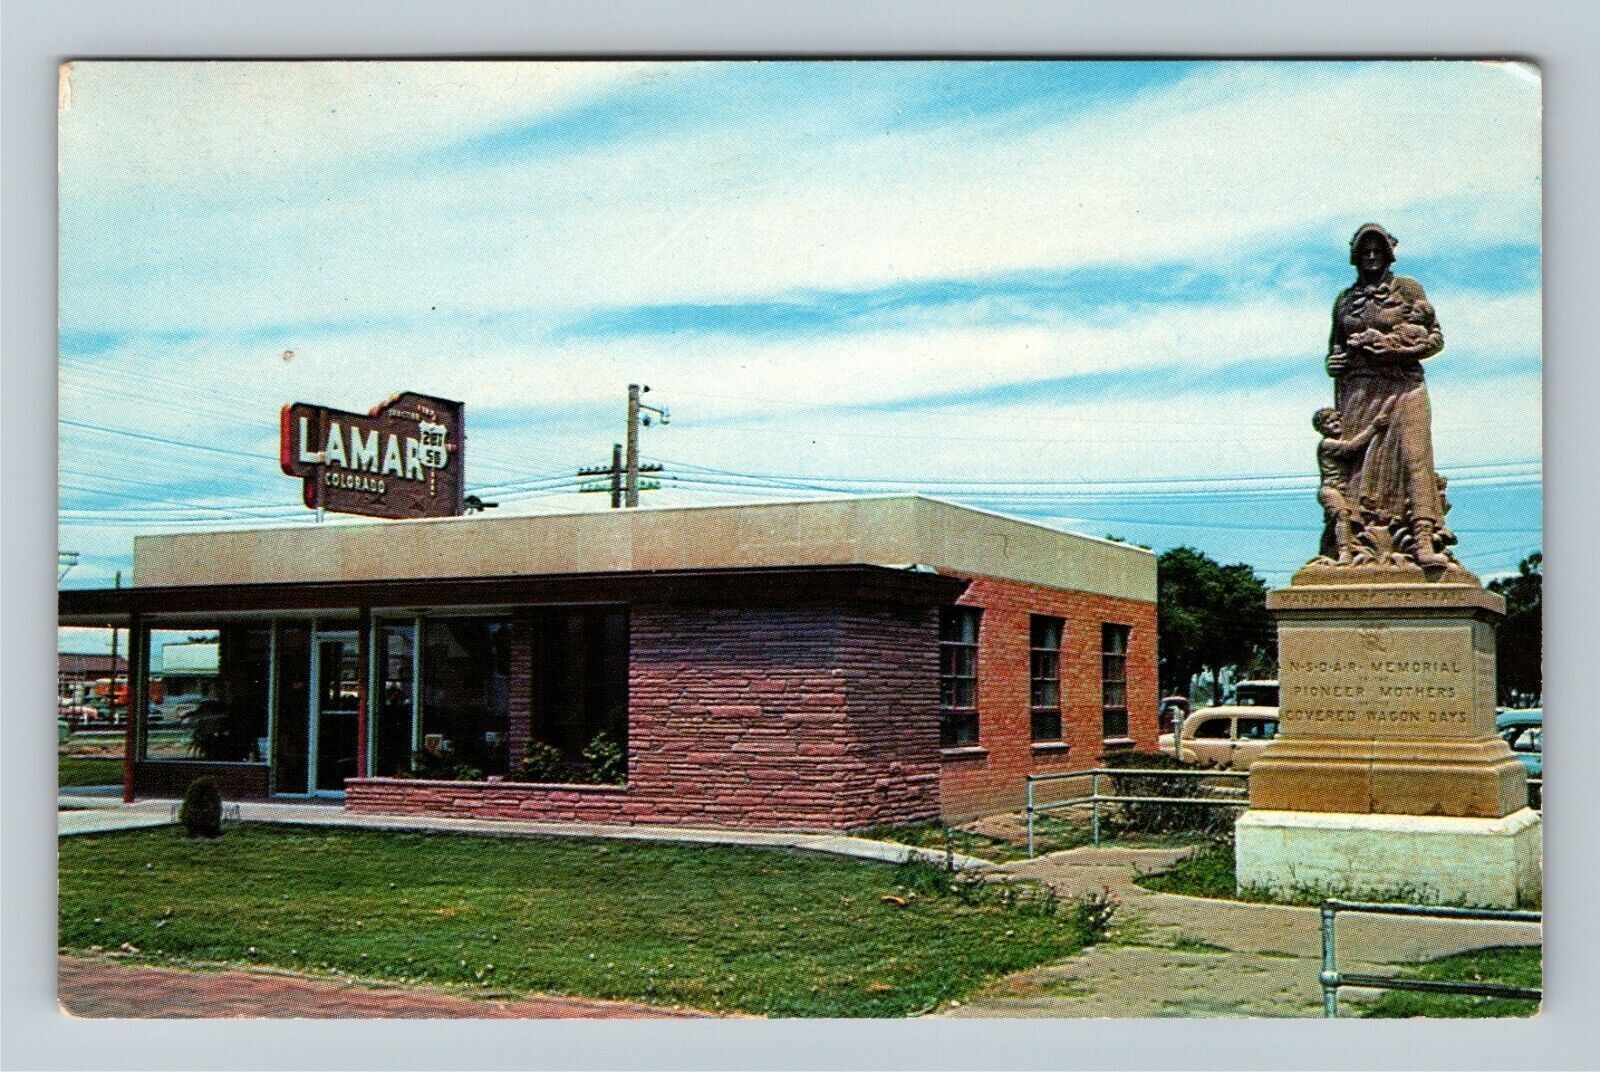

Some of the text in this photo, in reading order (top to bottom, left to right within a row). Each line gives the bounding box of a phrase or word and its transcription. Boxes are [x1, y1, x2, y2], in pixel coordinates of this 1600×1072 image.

[298, 416, 425, 482] LAMAR
[325, 472, 385, 494] COLORADO
[1370, 661, 1461, 673] MEMORIAL
[1294, 686, 1456, 698] PIONEER MOTHERS
[1286, 710, 1467, 722] COVERED WAGON DAYS
